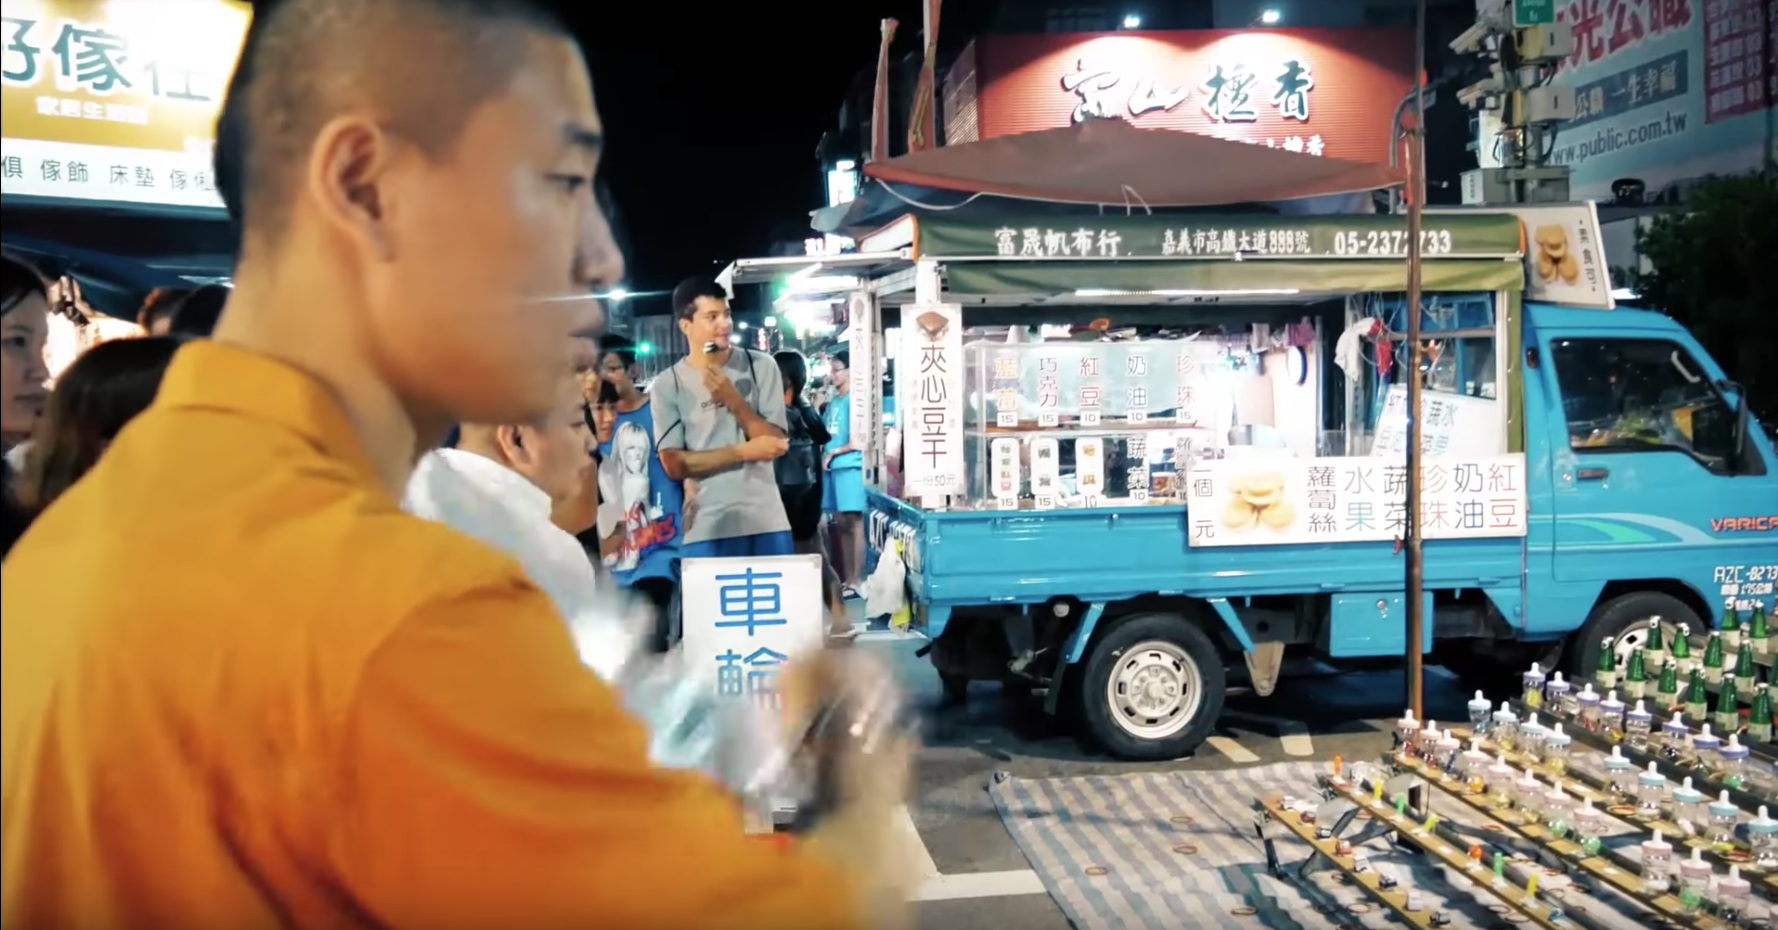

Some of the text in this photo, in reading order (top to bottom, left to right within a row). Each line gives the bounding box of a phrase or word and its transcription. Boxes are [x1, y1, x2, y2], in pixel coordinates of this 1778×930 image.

[1541, 0, 1692, 78] 光公職
[40, 158, 89, 183] 傢飾
[109, 165, 155, 188] 床墊
[994, 227, 1122, 257] 富晟帆布行
[1039, 357, 1058, 408] 巧克力
[1079, 357, 1099, 408] 紅豆
[1127, 356, 1147, 406] 奶油
[1176, 355, 1196, 404] 珍珠
[920, 343, 948, 470] 夾心豆干
[1001, 413, 1013, 424] 15
[1041, 412, 1054, 424] 15
[1085, 411, 1098, 423] 10
[1131, 410, 1145, 422] 10
[1179, 410, 1193, 422] 15
[913, 474, 957, 487] 一份50元
[1193, 469, 1213, 497] 一個
[1488, 462, 1518, 529] 紅豆
[1001, 499, 1013, 507] 15
[1039, 498, 1051, 507] 15
[1085, 495, 1097, 508] 10
[1133, 492, 1145, 501] 10
[1307, 466, 1337, 533] 蘿蔔絲
[1344, 465, 1375, 532] 水果
[1383, 464, 1409, 531] 蔬菜
[1453, 463, 1484, 529] 奶油
[1195, 520, 1215, 539] 元
[1714, 565, 1778, 583] AZC-8273
[714, 567, 788, 702] 車輪
